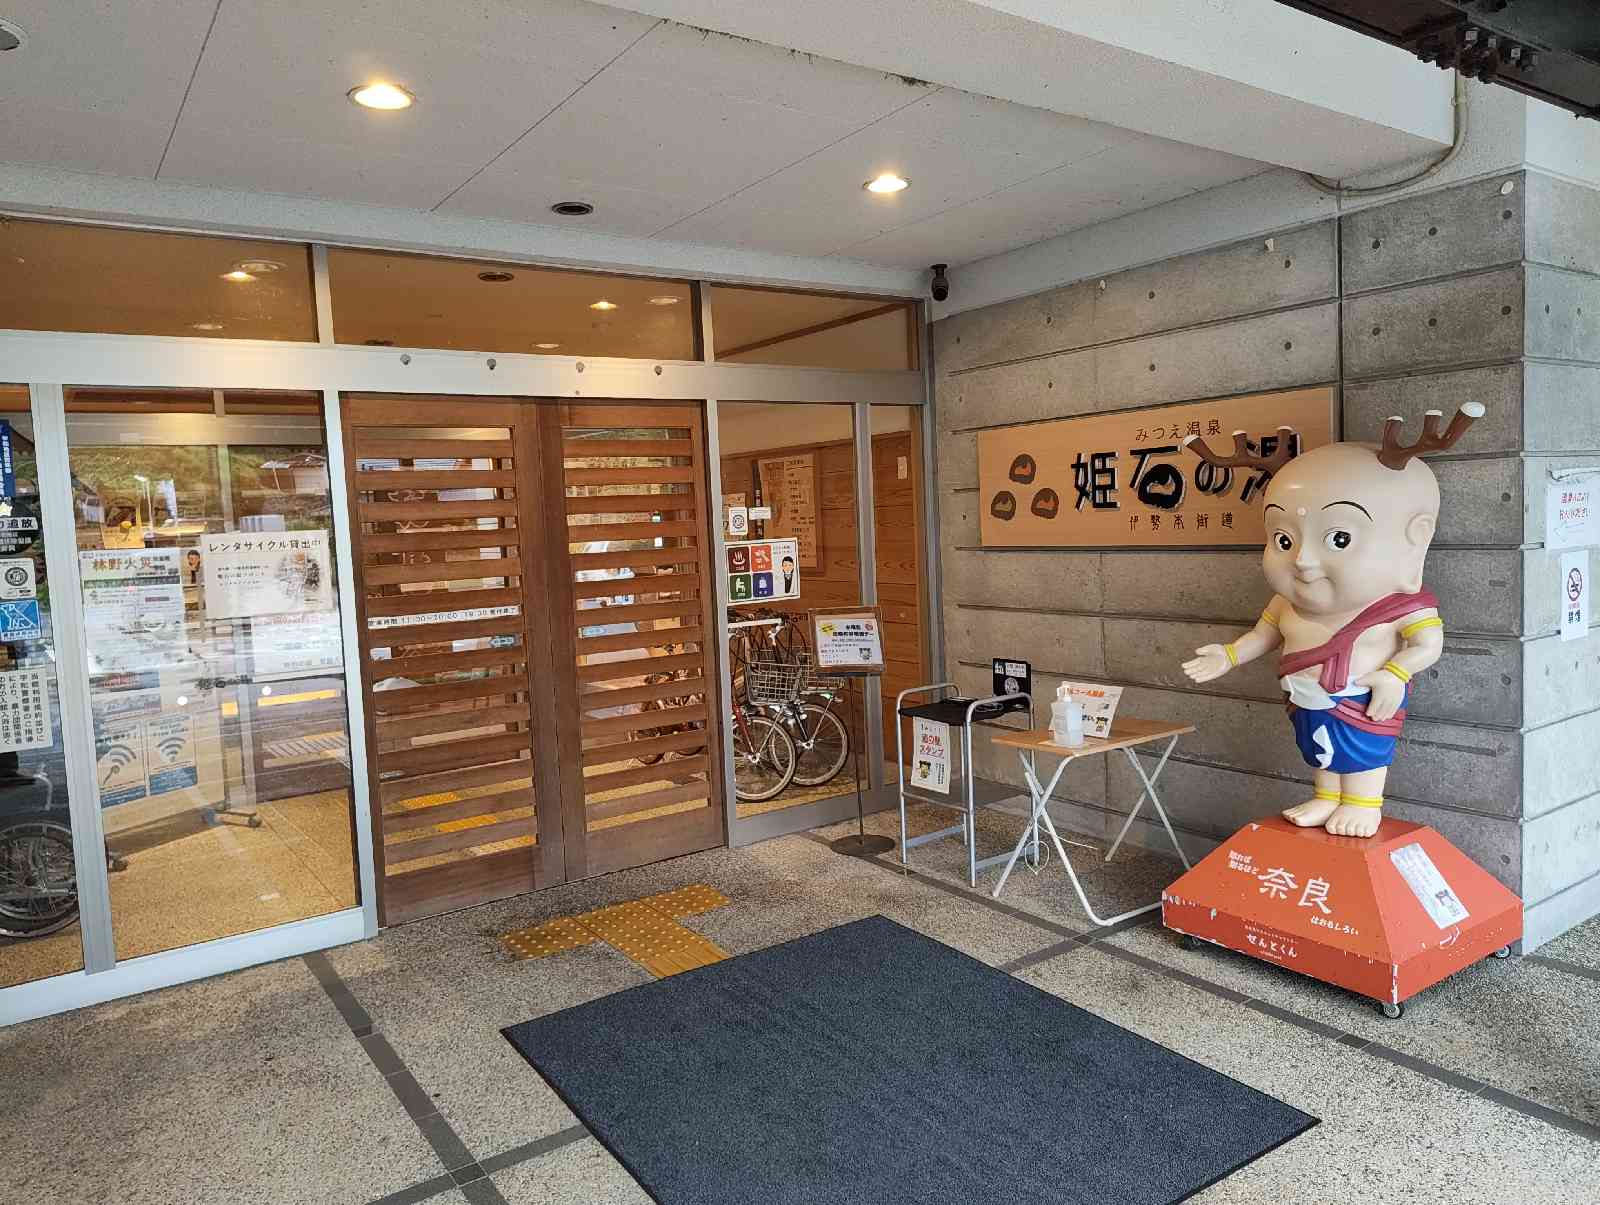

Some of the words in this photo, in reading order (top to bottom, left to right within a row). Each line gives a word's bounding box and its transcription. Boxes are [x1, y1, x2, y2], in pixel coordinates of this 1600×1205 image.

[1136, 418, 1223, 441] みつえ温泉
[1129, 512, 1235, 531] 伊勢本街道
[209, 539, 321, 552] レンタサイクル貸出中
[1257, 866, 1333, 915] 奈良
[1246, 932, 1298, 959] せんとくん
